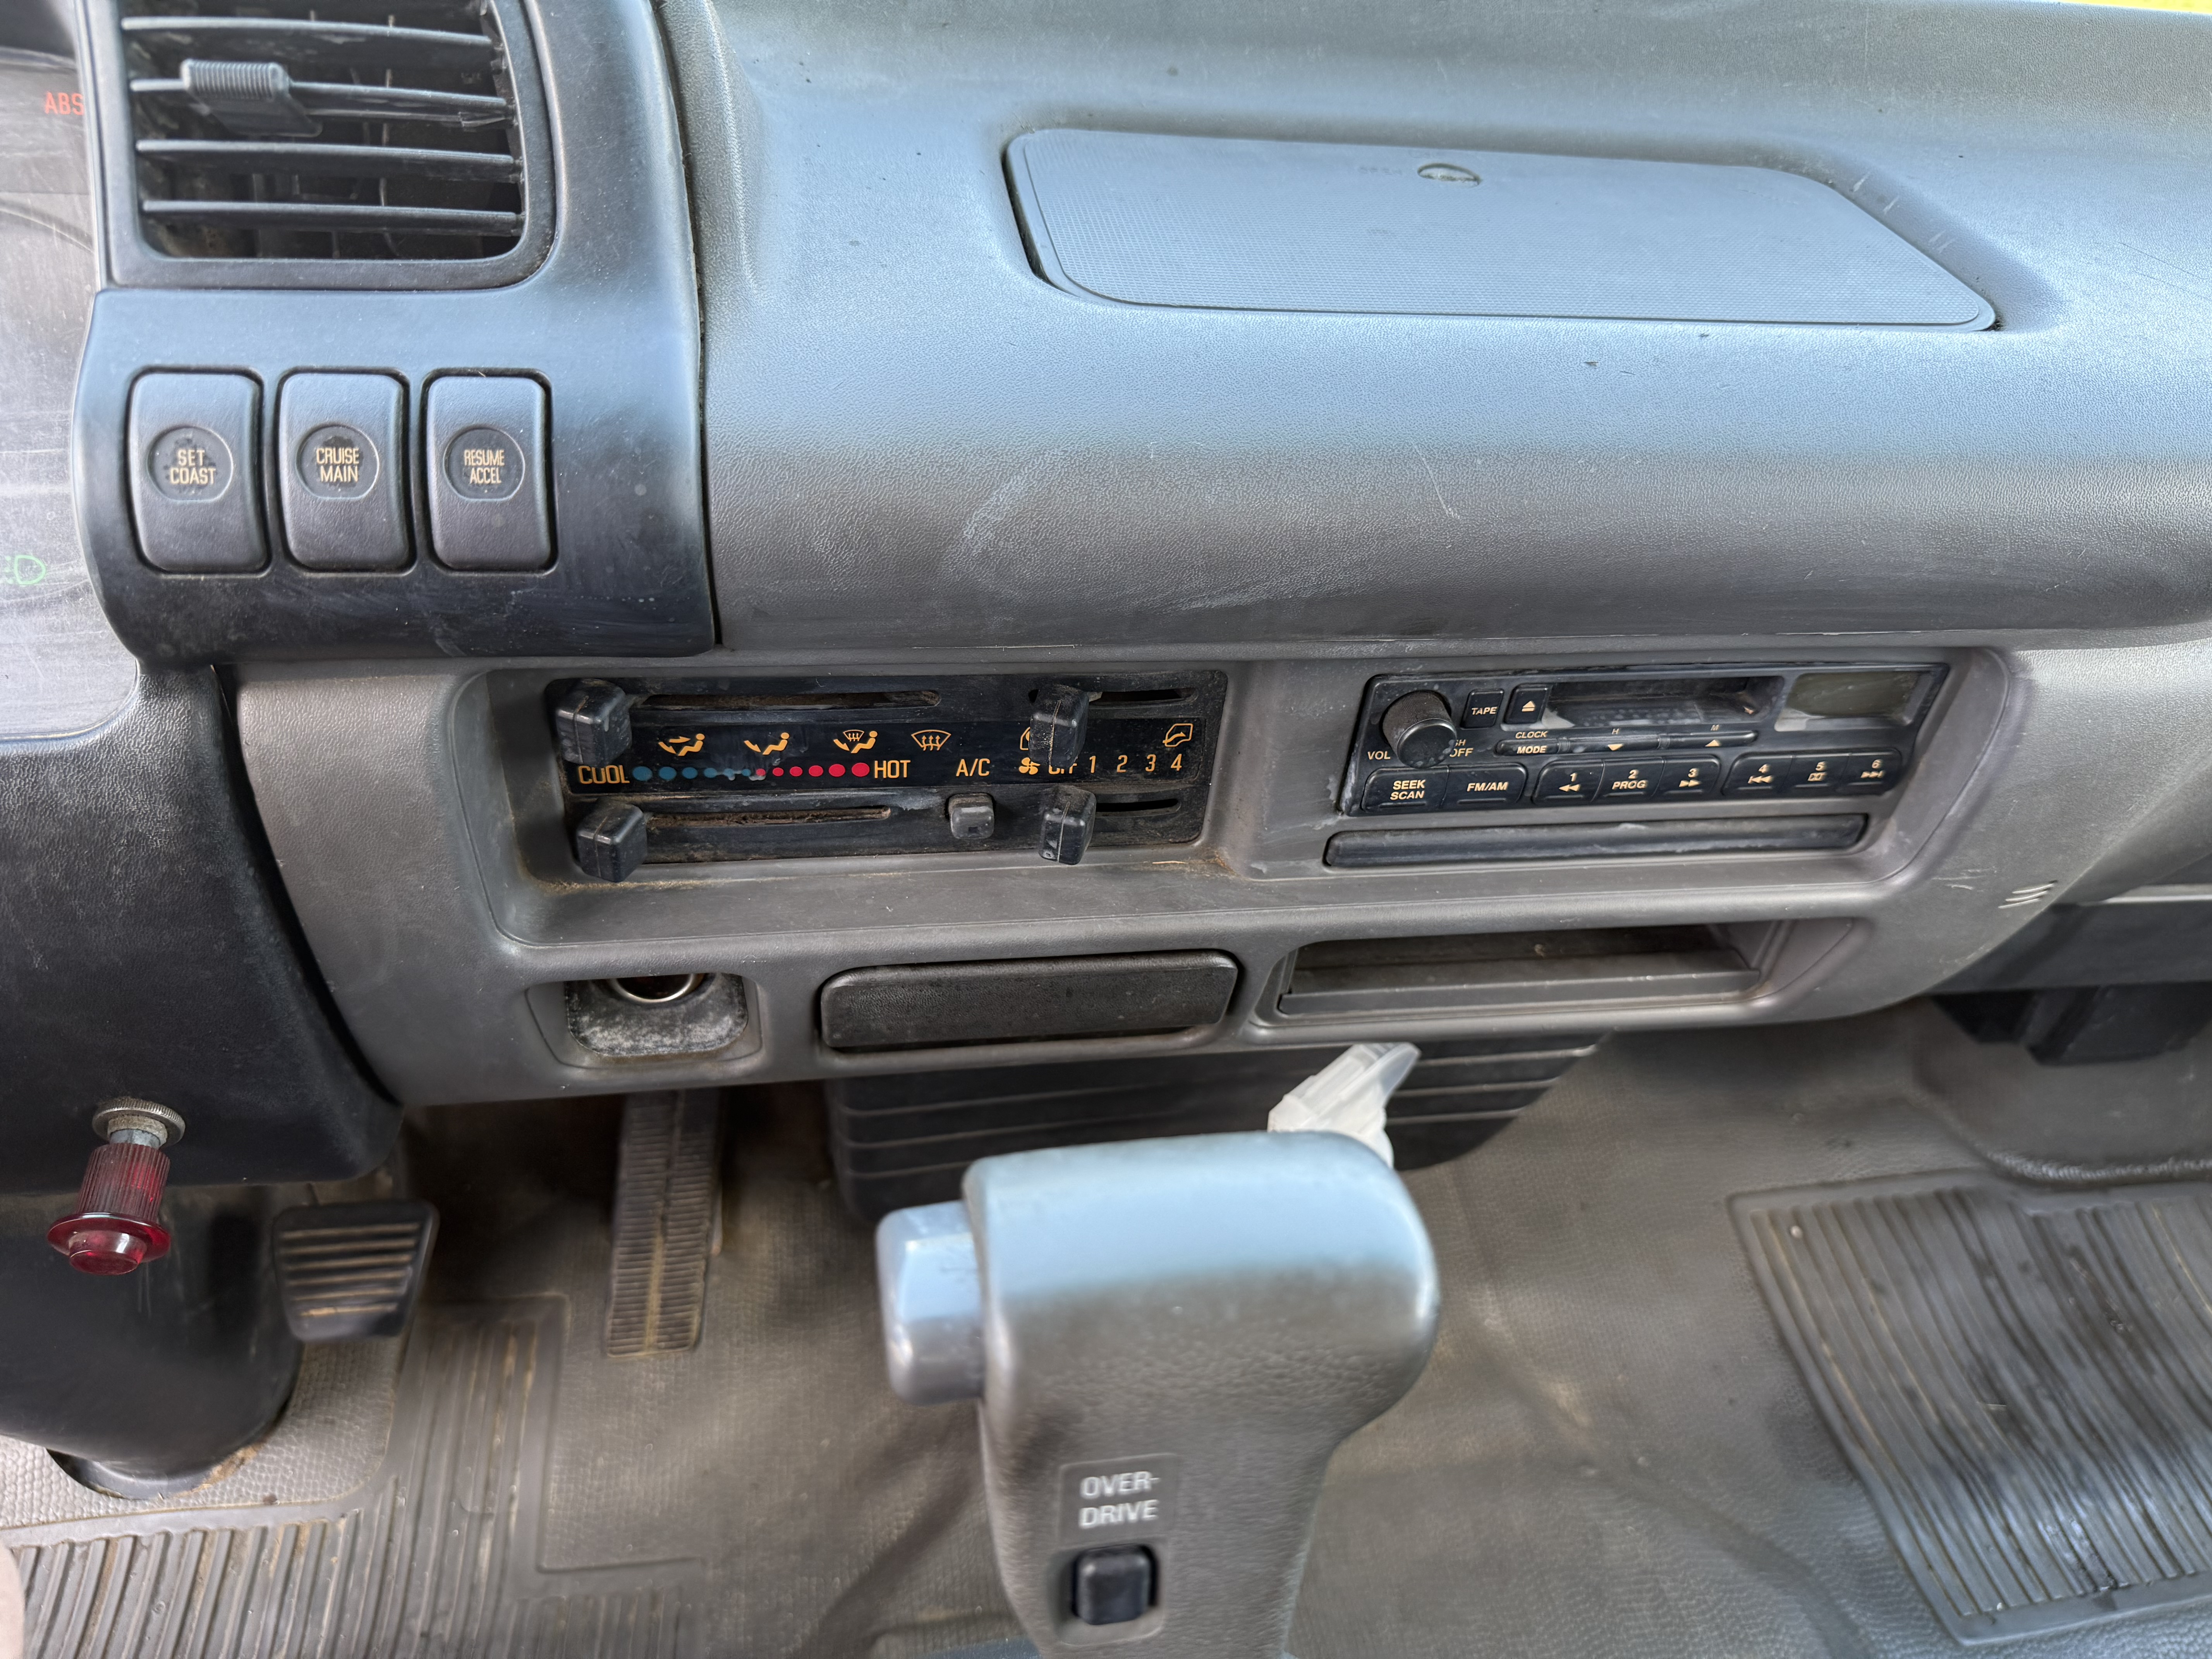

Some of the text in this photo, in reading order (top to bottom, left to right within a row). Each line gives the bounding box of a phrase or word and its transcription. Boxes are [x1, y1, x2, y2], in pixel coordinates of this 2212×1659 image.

[45, 91, 84, 115] ABS
[177, 449, 205, 466] SET
[316, 447, 359, 465] CRUISE
[464, 449, 505, 466] RESUME
[170, 467, 216, 484] COAST
[320, 466, 358, 483] MAIN
[469, 467, 502, 484] ACCEL
[1471, 706, 1498, 715] TAPE
[1515, 730, 1548, 739] CLOCK
[1449, 748, 1474, 757] OFF
[1516, 745, 1547, 754] MODE
[1367, 751, 1391, 760] VOL
[874, 760, 911, 778] HOT
[956, 758, 991, 776] A/C
[1089, 756, 1096, 773] 1
[1116, 755, 1128, 773] 2
[1145, 754, 1156, 772] 3
[1171, 754, 1182, 771] 4
[1759, 763, 1770, 774] 4
[1815, 761, 1826, 771] 5
[1872, 759, 1882, 769] 6
[1570, 773, 1578, 781] 1
[1628, 769, 1638, 779] 2
[1687, 768, 1698, 778] 3
[1393, 780, 1426, 790] SEEK
[1467, 781, 1509, 792] FM/AM
[1612, 780, 1648, 790] PROG
[1390, 791, 1425, 800] SCAN
[1080, 1471, 1160, 1499] OVER-
[1079, 1499, 1160, 1529] DRIVE
